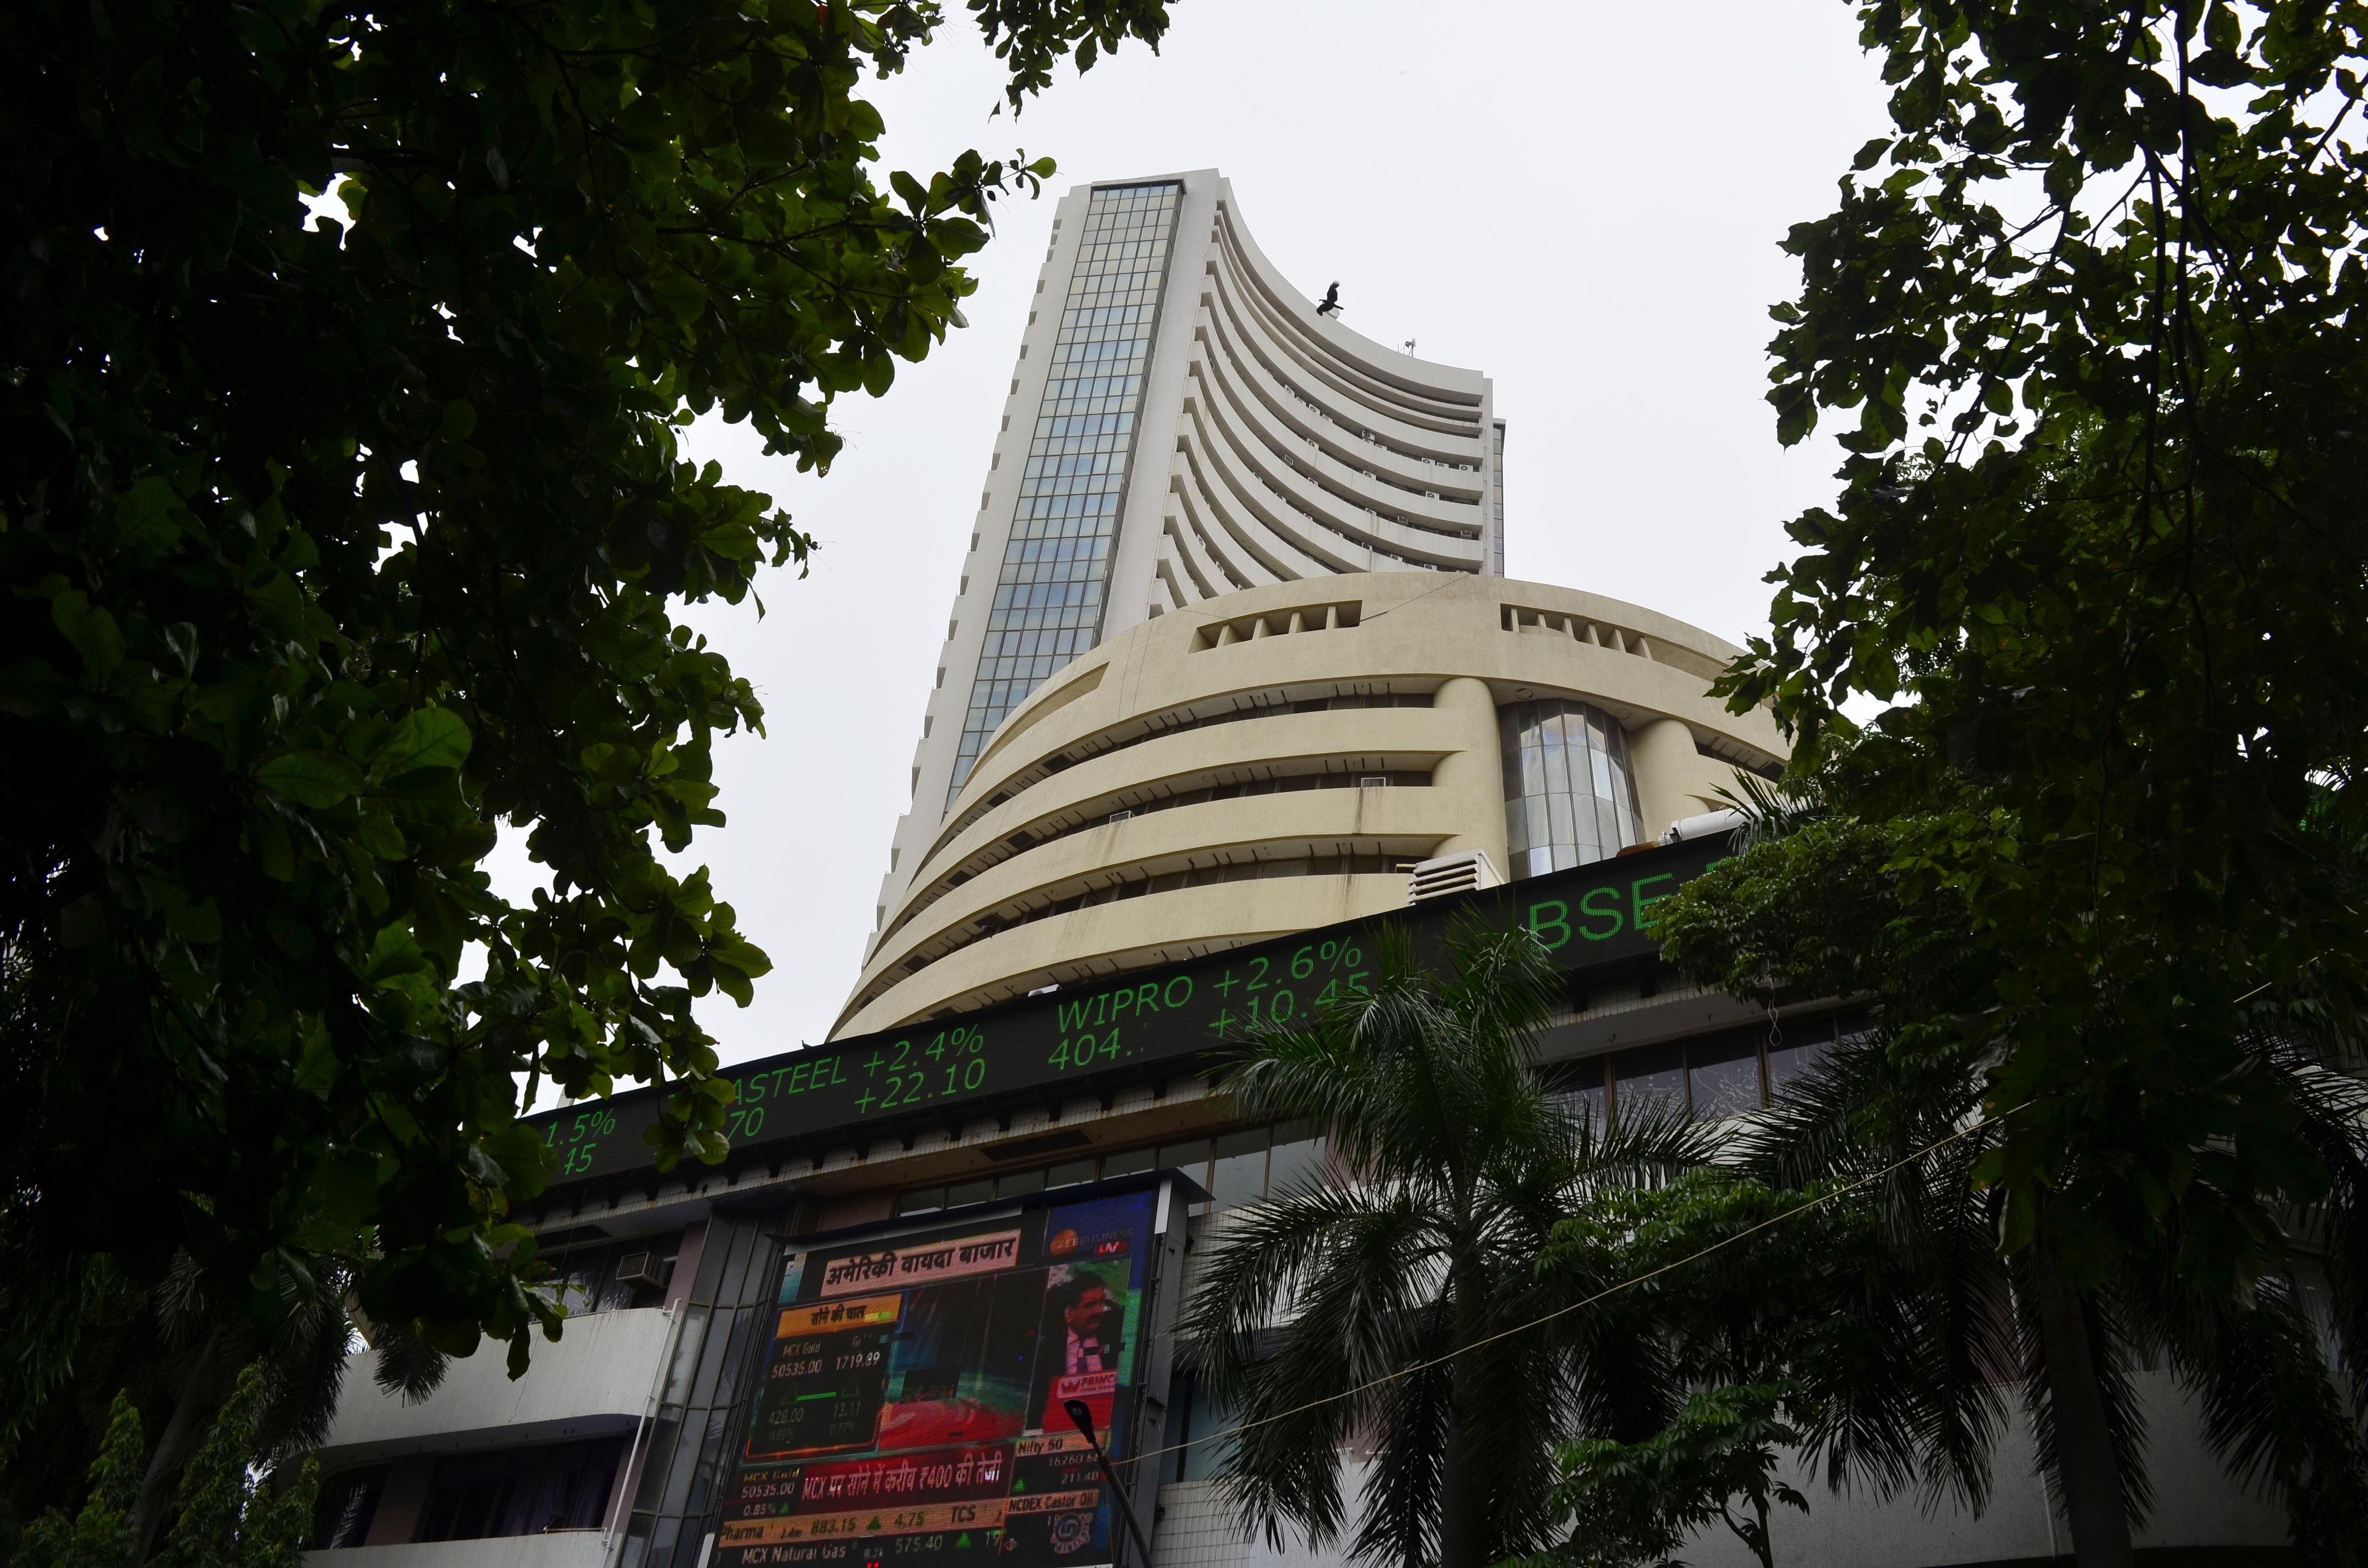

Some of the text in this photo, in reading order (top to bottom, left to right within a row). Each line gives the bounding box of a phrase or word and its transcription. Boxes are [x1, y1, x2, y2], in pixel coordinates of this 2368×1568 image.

[1529, 872, 1673, 954] BSE
[1058, 936, 1362, 1033] WIPRO +2.6%
[1209, 971, 1370, 1037] +10.45
[668, 1023, 984, 1105] ASTEEL +2.4%
[854, 1058, 986, 1113] +22.10
[826, 1238, 1015, 1285] अमेरिकी वायदा बाजार
[831, 1303, 844, 1323] की
[783, 1341, 821, 1358] MCX Gold
[772, 1360, 822, 1379] 50535.00
[836, 1352, 880, 1370] 1719.89
[832, 1400, 861, 1418] 13.11
[1048, 1439, 1063, 1450] 50
[744, 1471, 768, 1482] MCX
[802, 1476, 826, 1501] MCX
[848, 1464, 871, 1496] सोने
[873, 1463, 885, 1494] में
[885, 1459, 917, 1493] करीब
[956, 1452, 974, 1487] की
[741, 1482, 795, 1498] 50535.00
[743, 1503, 777, 1516] 0.85%
[1010, 1491, 1094, 1512] NCDEX Castor Oil
[811, 1518, 856, 1534] 883.15
[951, 1505, 976, 1523] TCS
[742, 1547, 768, 1564] MCX
[772, 1546, 816, 1563] Natural
[896, 1535, 942, 1554] 575.40
